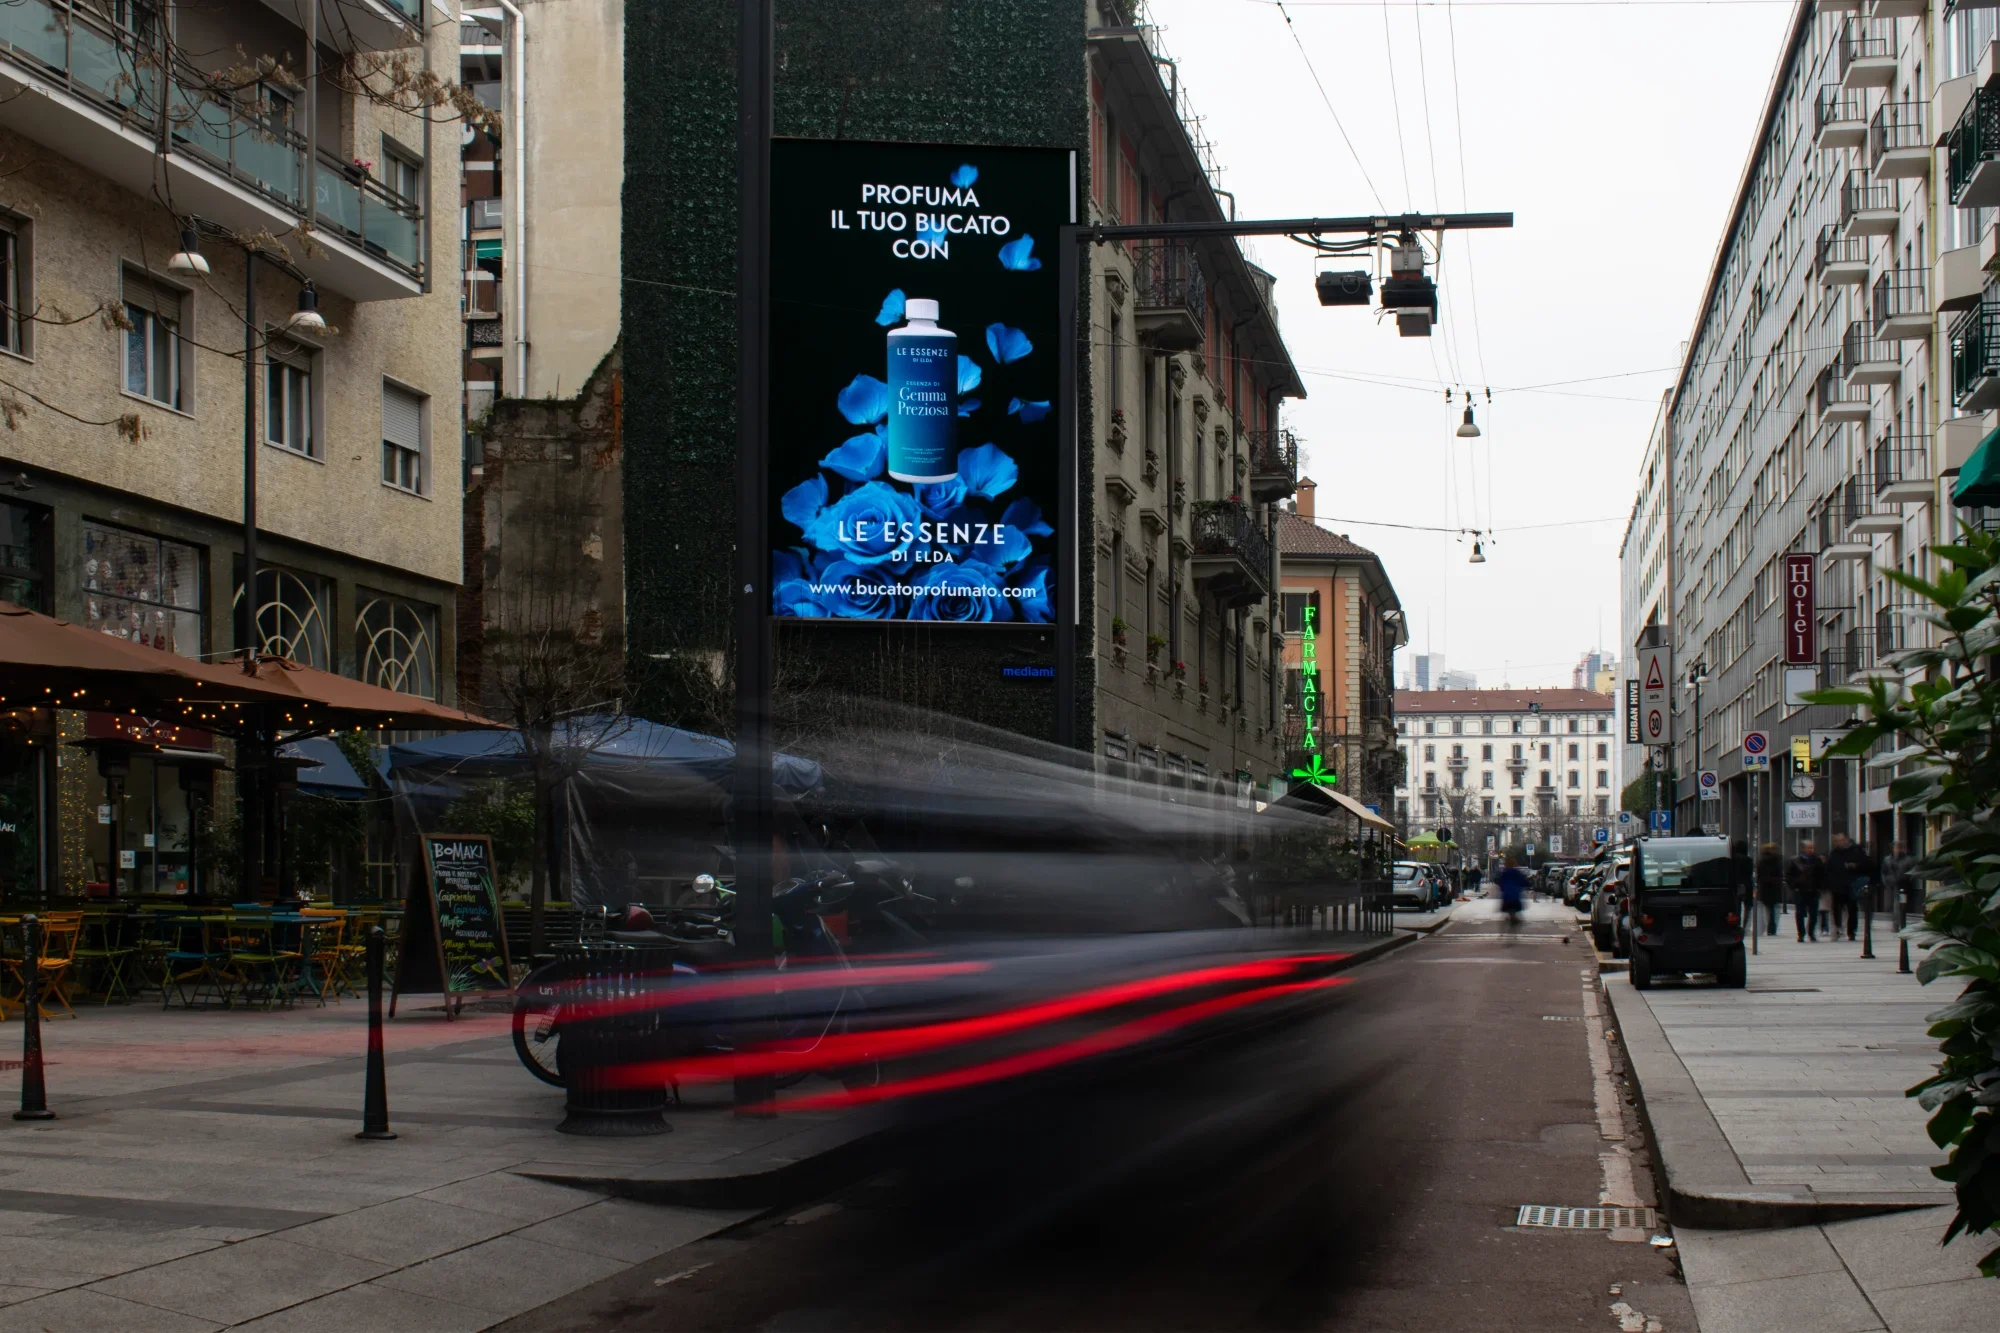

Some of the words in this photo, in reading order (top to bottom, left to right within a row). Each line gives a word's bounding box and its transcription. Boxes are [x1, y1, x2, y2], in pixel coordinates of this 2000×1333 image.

[862, 184, 980, 208] PROFUMA
[831, 209, 850, 230] IL
[857, 210, 907, 232] TUO
[915, 212, 1011, 236] BUCATO
[892, 238, 949, 260] CON
[896, 347, 907, 356] LE
[910, 347, 948, 357] ESSENZE
[899, 386, 947, 402] Gemma
[897, 401, 949, 416] Preziosa
[838, 520, 868, 542] LE
[883, 522, 1006, 545] ESSENZE
[891, 550, 908, 563] DI
[915, 551, 954, 563] ELDA
[808, 579, 1037, 599] www.bucatoprofumato.com
[1789, 564, 1811, 655] Hotel
[1302, 606, 1317, 748] FARMACIA
[1630, 682, 1639, 704] HIVE
[1630, 707, 1639, 742] URBAN
[1651, 717, 1660, 731] 30
